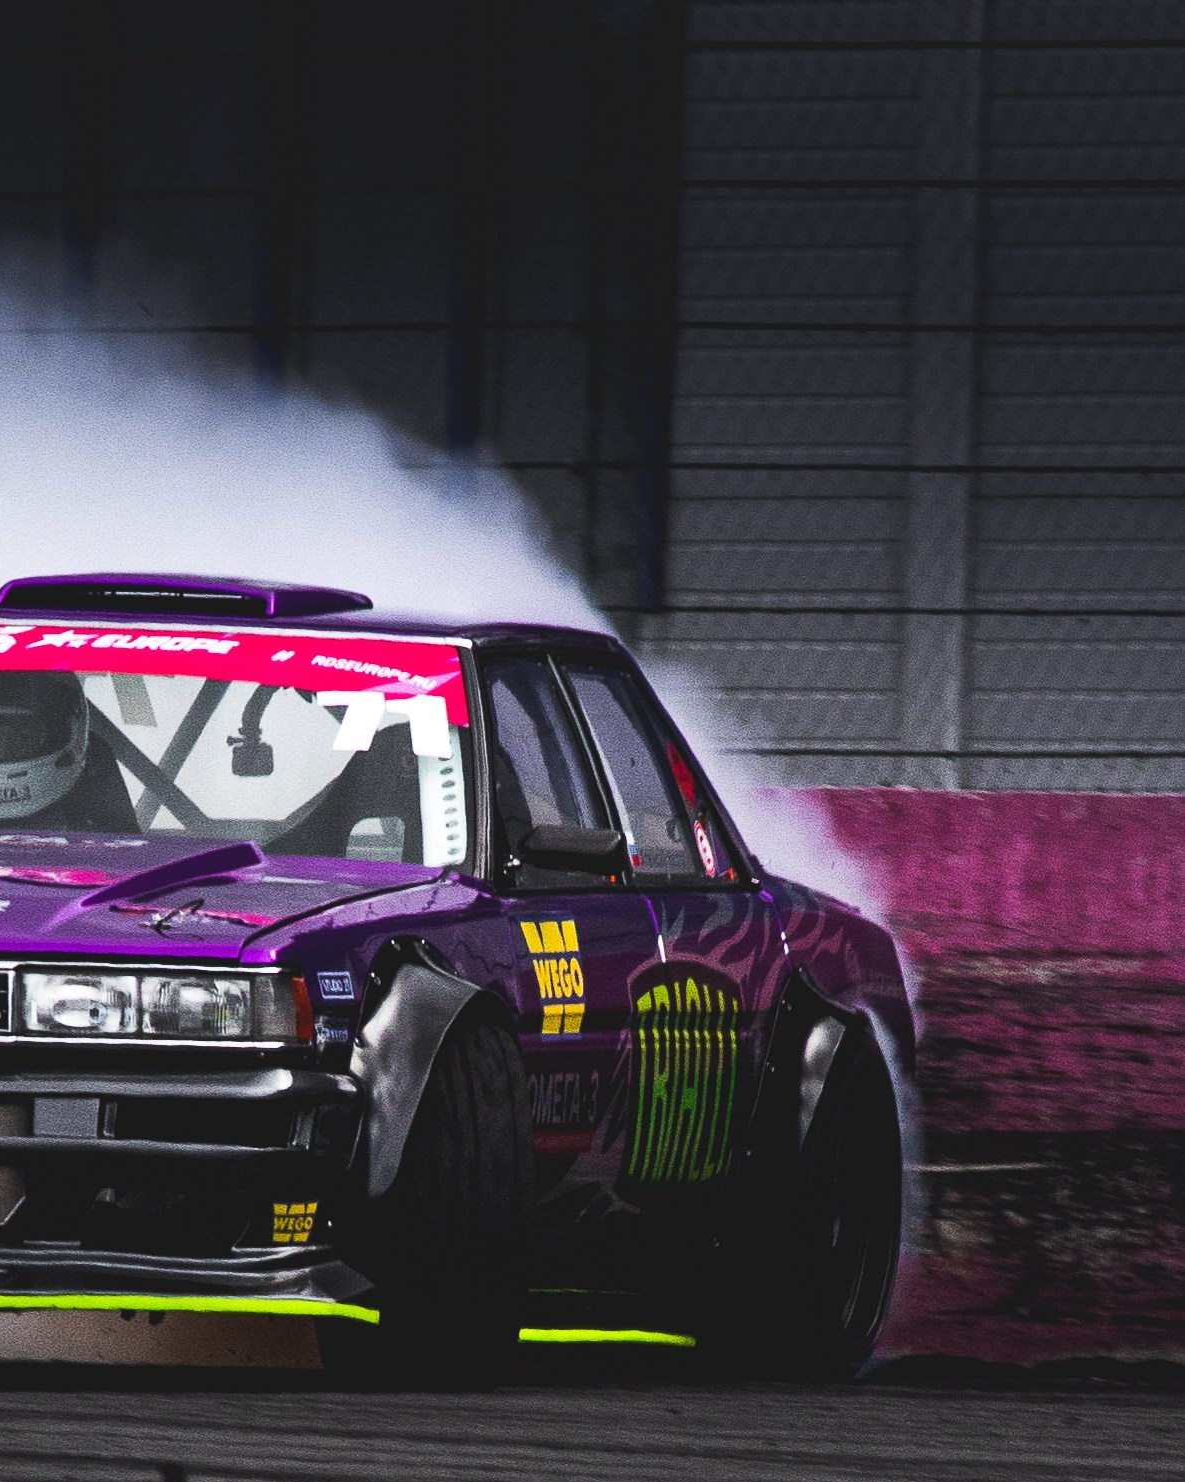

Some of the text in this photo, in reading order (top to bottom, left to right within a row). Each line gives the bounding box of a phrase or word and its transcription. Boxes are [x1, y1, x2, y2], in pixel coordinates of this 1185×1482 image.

[91, 633, 241, 655] EUROPE
[316, 690, 452, 759] 71
[532, 957, 584, 999] WEGO
[273, 1216, 314, 1231] WEGO
